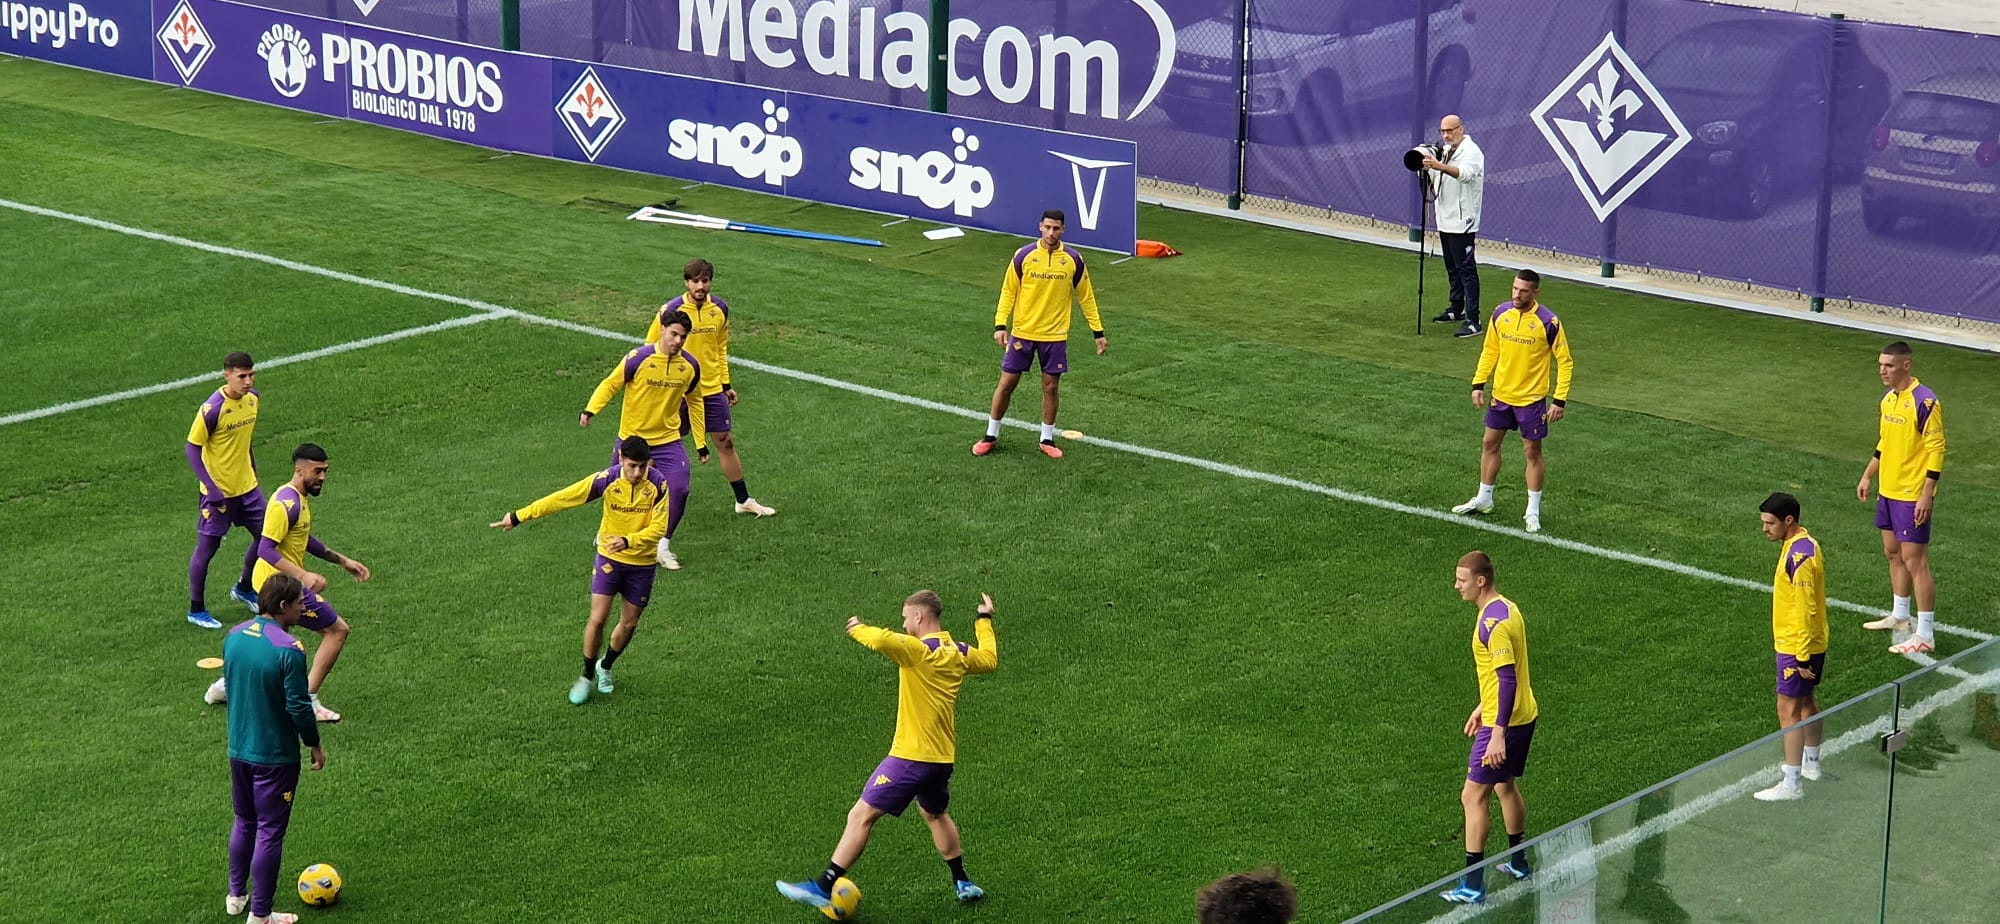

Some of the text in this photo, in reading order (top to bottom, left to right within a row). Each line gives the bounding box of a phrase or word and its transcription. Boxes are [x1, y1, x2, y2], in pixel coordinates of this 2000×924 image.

[0, 0, 119, 48] ippyPro
[257, 23, 317, 69] PROBIOS
[322, 33, 503, 113] PROBIOS
[677, 0, 1120, 120] Mediacom
[352, 89, 476, 132] BIOLOGICO DAL 1978
[668, 118, 803, 186] snep
[849, 146, 995, 217] snep
[1031, 271, 1065, 280] Mediacom
[1502, 333, 1532, 345] Mediacom
[611, 503, 649, 513] Mediacom
